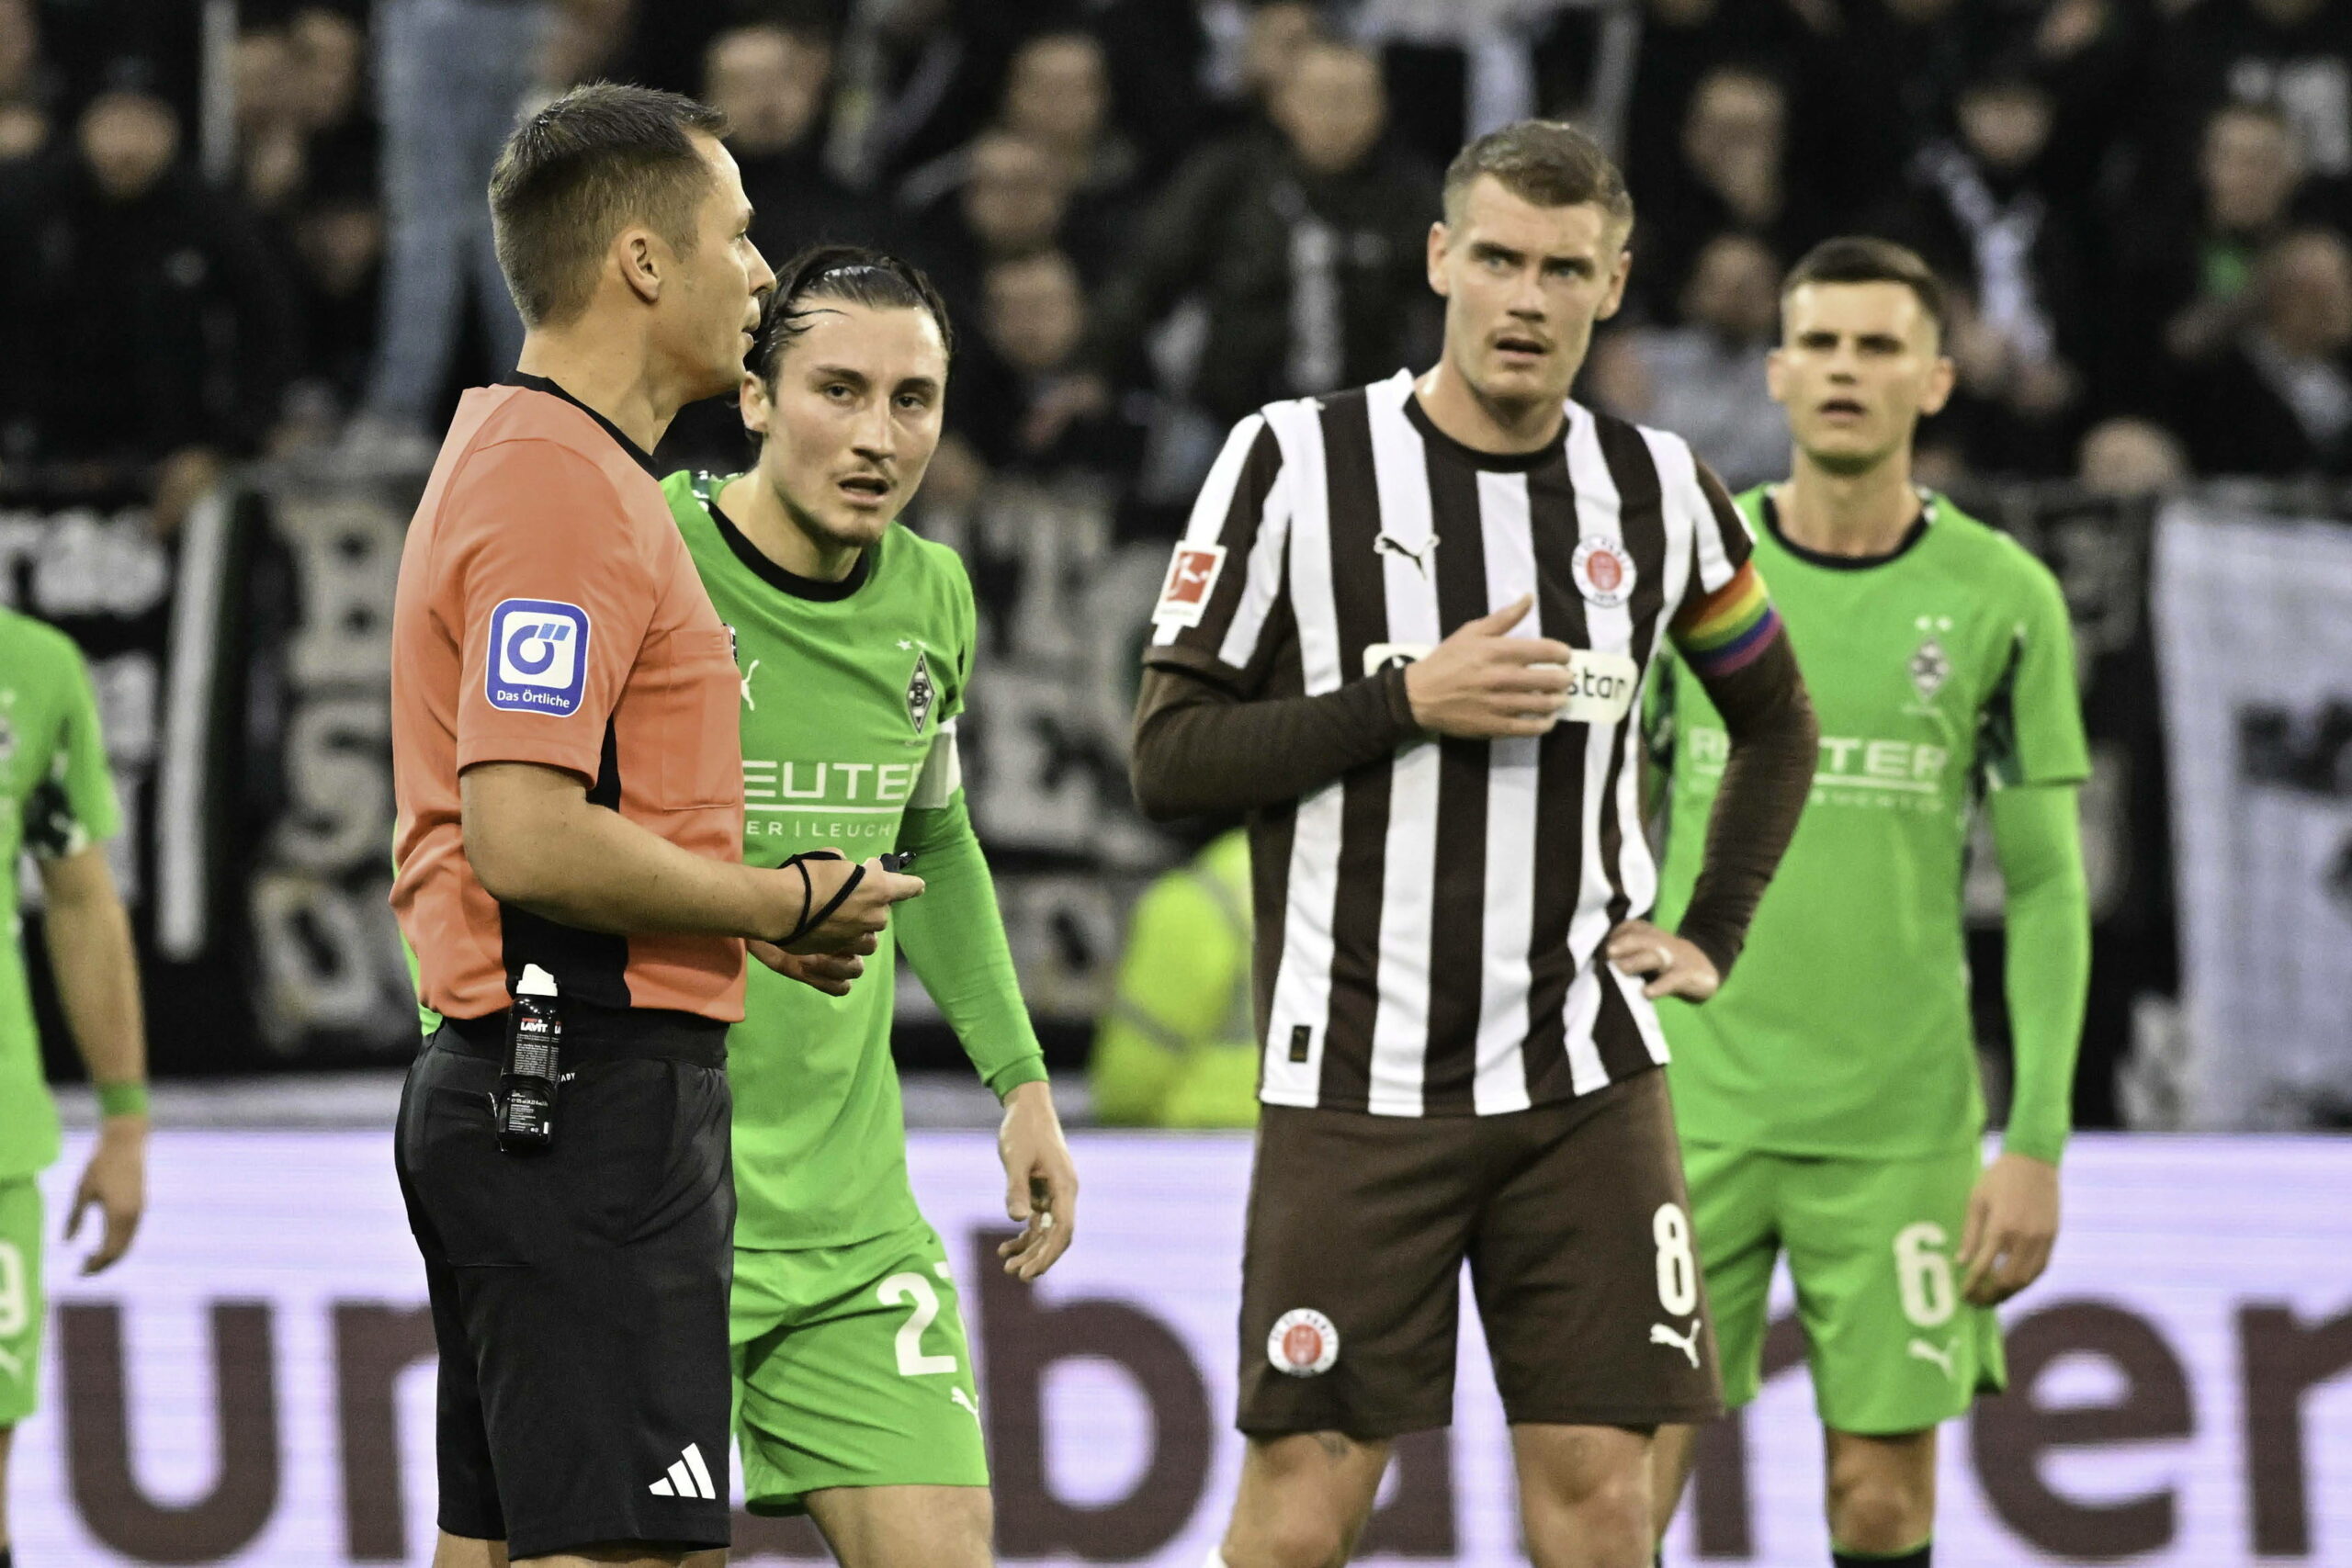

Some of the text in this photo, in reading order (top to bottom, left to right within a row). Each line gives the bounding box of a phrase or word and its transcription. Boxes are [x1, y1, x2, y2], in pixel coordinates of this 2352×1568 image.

[496, 689, 571, 708] Das Örtliche
[1567, 666, 1625, 700] star
[1689, 728, 1949, 779] RTER
[741, 760, 923, 800] EUTE
[745, 820, 783, 837] ER
[811, 821, 899, 839] LEUCH
[560, 1072, 576, 1082] ADY
[1653, 1201, 1697, 1316] 8
[1894, 1222, 1955, 1326] 6
[876, 1260, 958, 1377] 2
